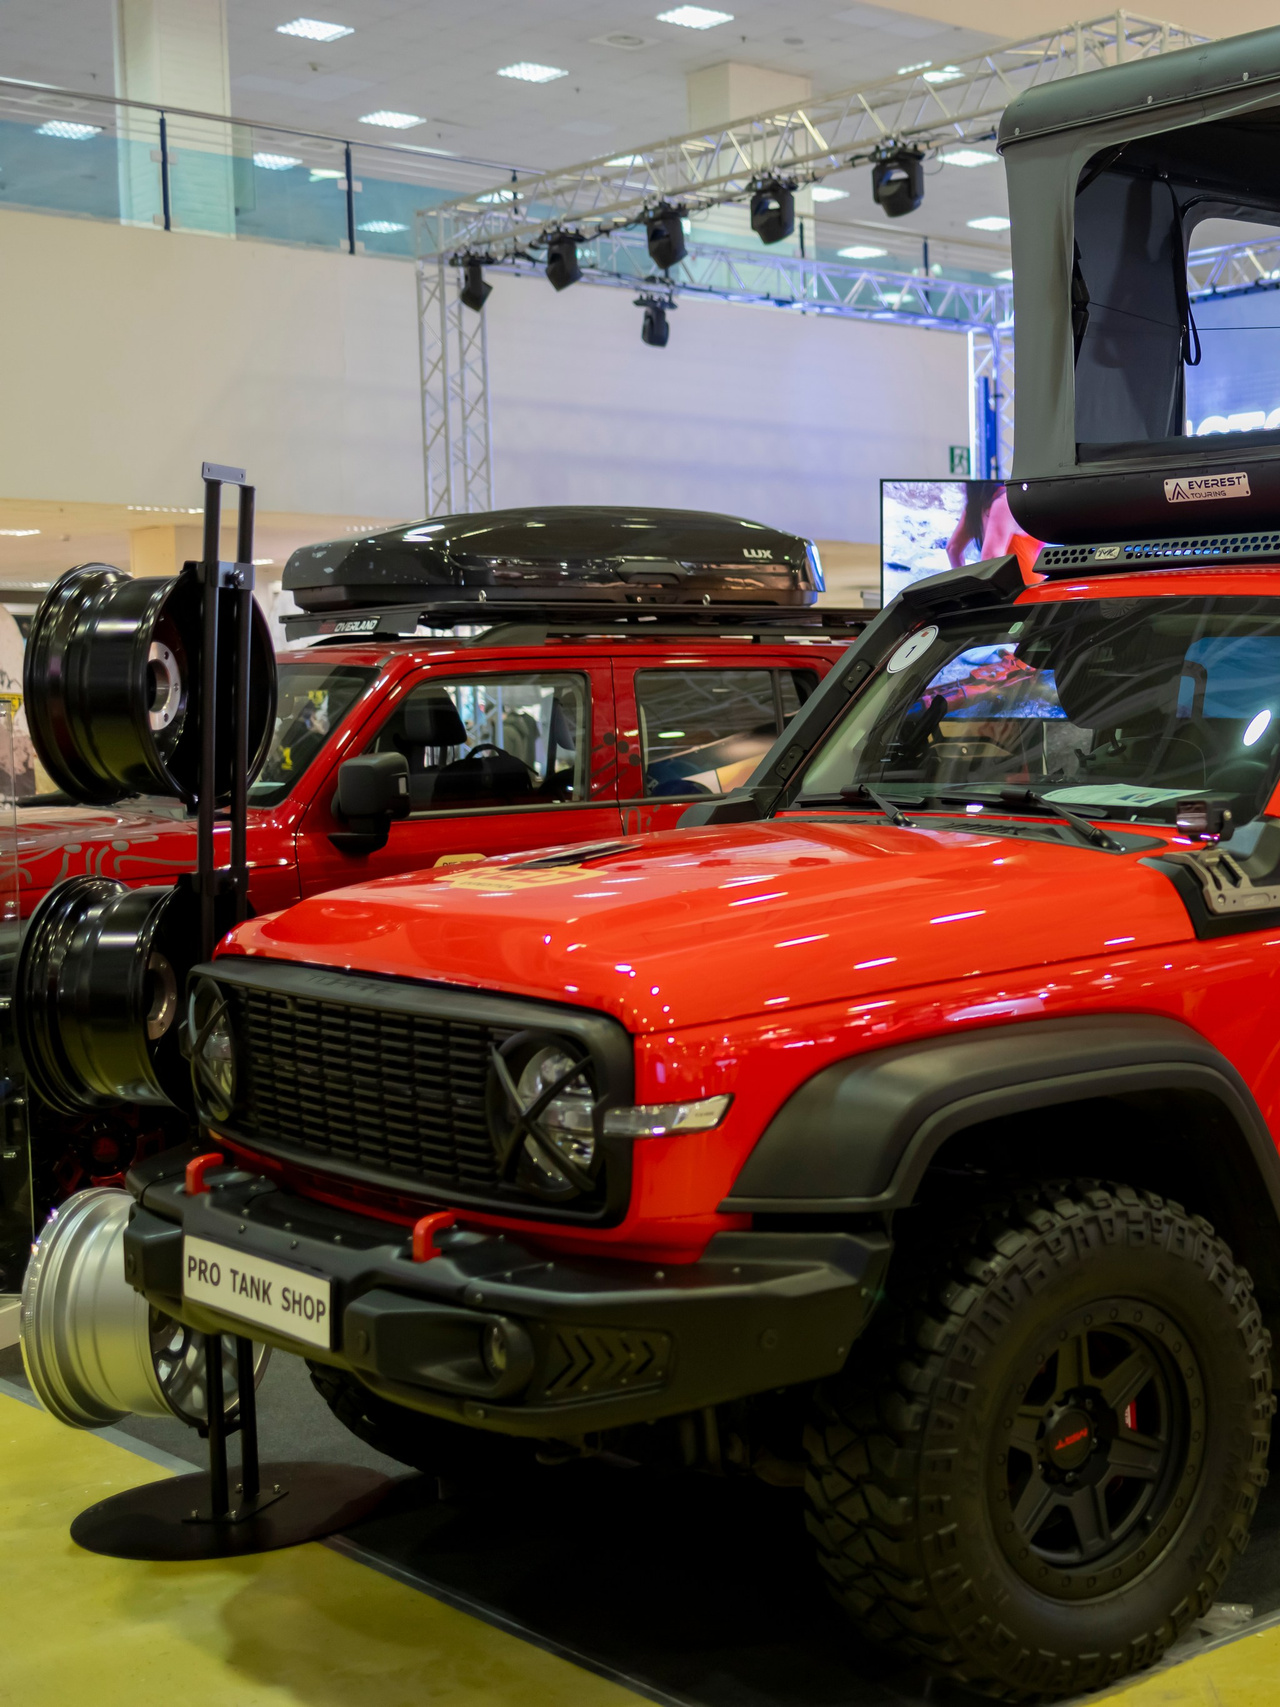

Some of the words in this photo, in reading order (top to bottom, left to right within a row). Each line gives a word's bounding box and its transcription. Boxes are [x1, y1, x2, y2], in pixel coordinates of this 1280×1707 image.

[1188, 476, 1242, 490] EVEREST
[1191, 490, 1227, 499] TOURING
[742, 548, 773, 559] LUX
[334, 620, 379, 632] OVERLAND
[188, 1255, 221, 1287] PRO
[230, 1268, 272, 1306] TANK
[281, 1286, 326, 1323] SHOP
